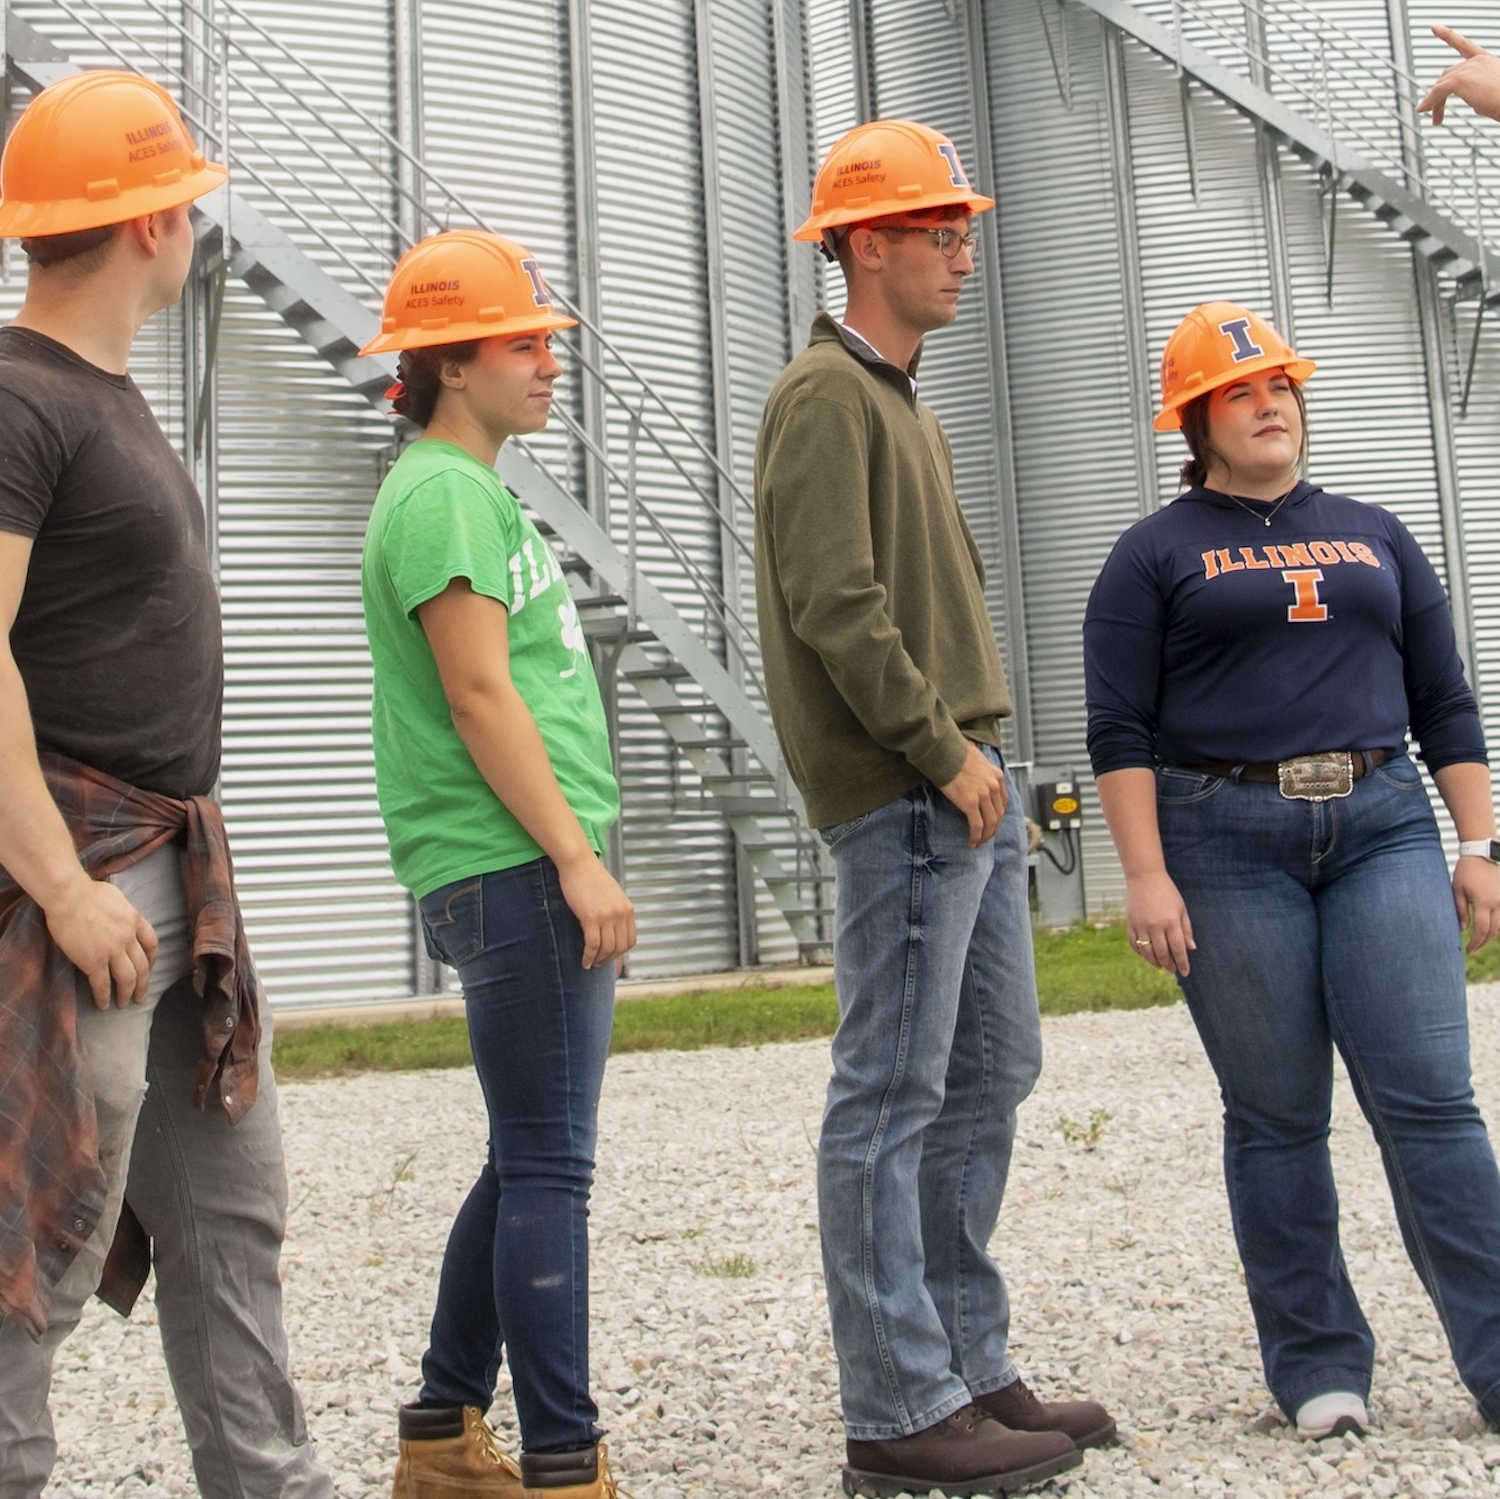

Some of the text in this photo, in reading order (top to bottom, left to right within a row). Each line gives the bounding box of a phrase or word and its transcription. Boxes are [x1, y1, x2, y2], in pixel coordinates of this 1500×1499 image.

[126, 121, 173, 145] ILLINOIS
[128, 145, 157, 163] ACES
[937, 143, 969, 188] I
[836, 159, 882, 176] ILLINOIS
[832, 172, 887, 190] ACES Safety
[410, 280, 460, 295] ILLINOIS
[519, 258, 551, 308] I
[405, 295, 465, 309] ACES Safety
[1218, 317, 1265, 364] I
[1201, 541, 1381, 581] ILLINOIS
[1281, 569, 1328, 623] I
